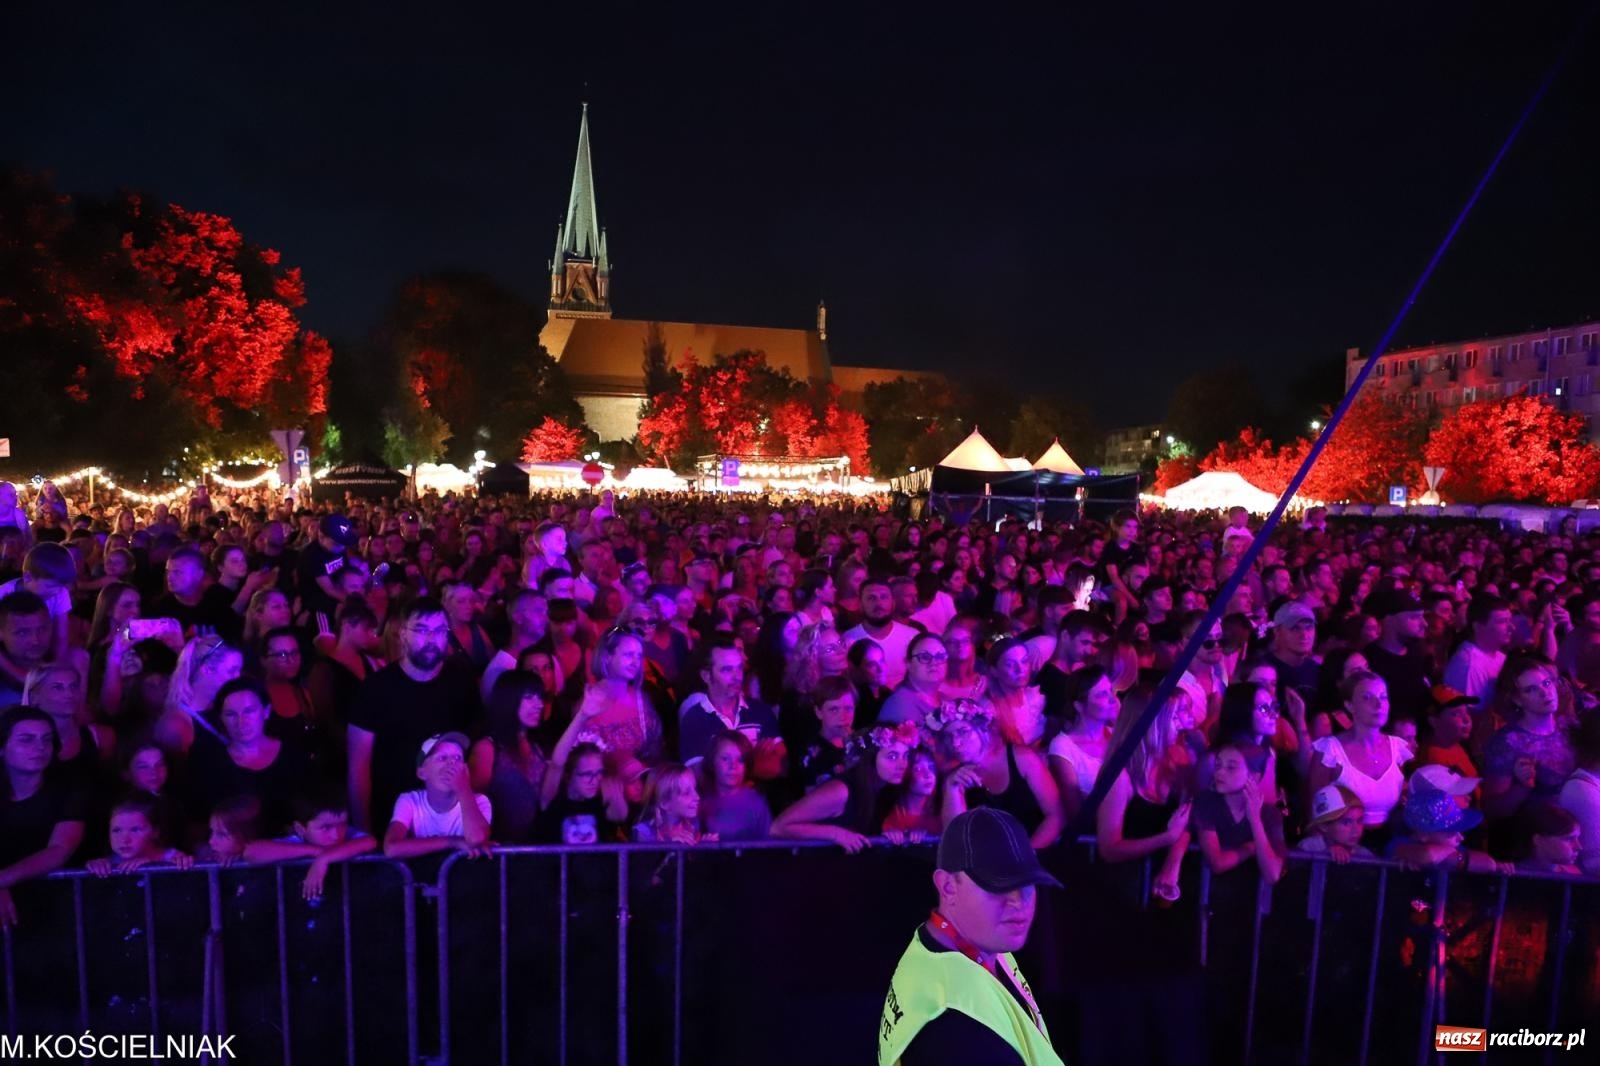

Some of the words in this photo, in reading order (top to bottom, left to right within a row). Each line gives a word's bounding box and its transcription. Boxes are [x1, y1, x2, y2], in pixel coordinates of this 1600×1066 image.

[294, 449, 305, 464] P
[725, 460, 736, 475] P
[1393, 488, 1403, 500] P
